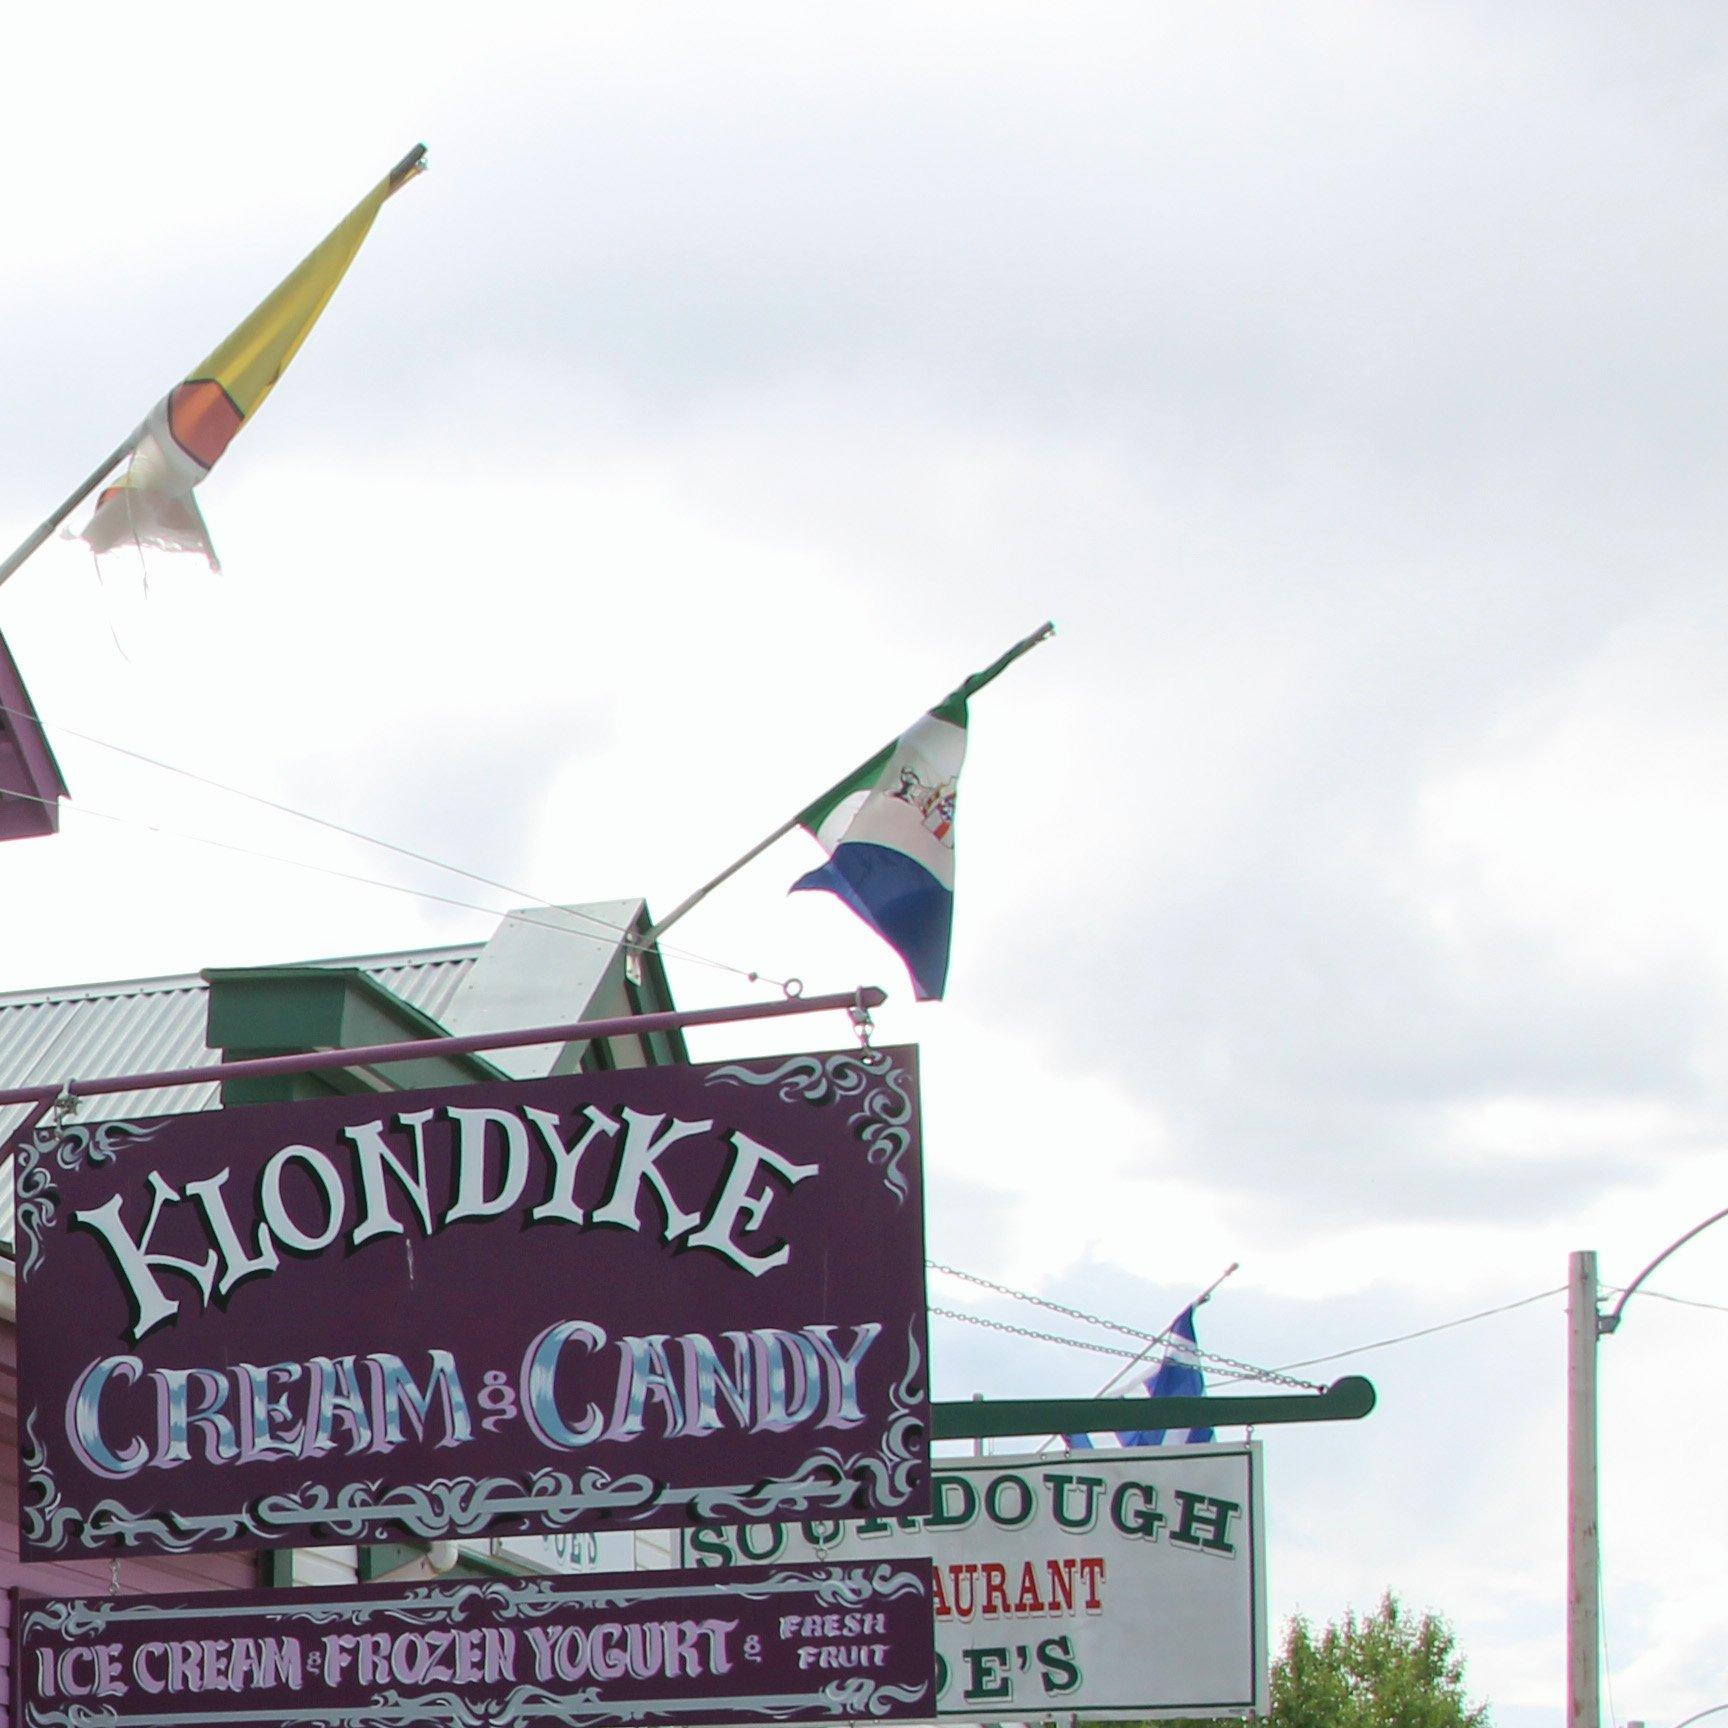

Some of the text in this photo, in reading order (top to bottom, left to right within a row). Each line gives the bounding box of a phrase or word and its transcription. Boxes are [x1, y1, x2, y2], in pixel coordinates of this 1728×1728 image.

[76, 1105, 820, 1339] KLONDYKE
[66, 1348, 474, 1480] CREAM
[520, 1319, 883, 1450] CANDY
[35, 1643, 129, 1698] ICE
[132, 1635, 303, 1695] CREAM
[321, 1627, 516, 1688] FROZEN
[526, 1619, 740, 1685] YOGURT
[779, 1612, 887, 1640] FRESH
[797, 1643, 891, 1671] FRUIT
